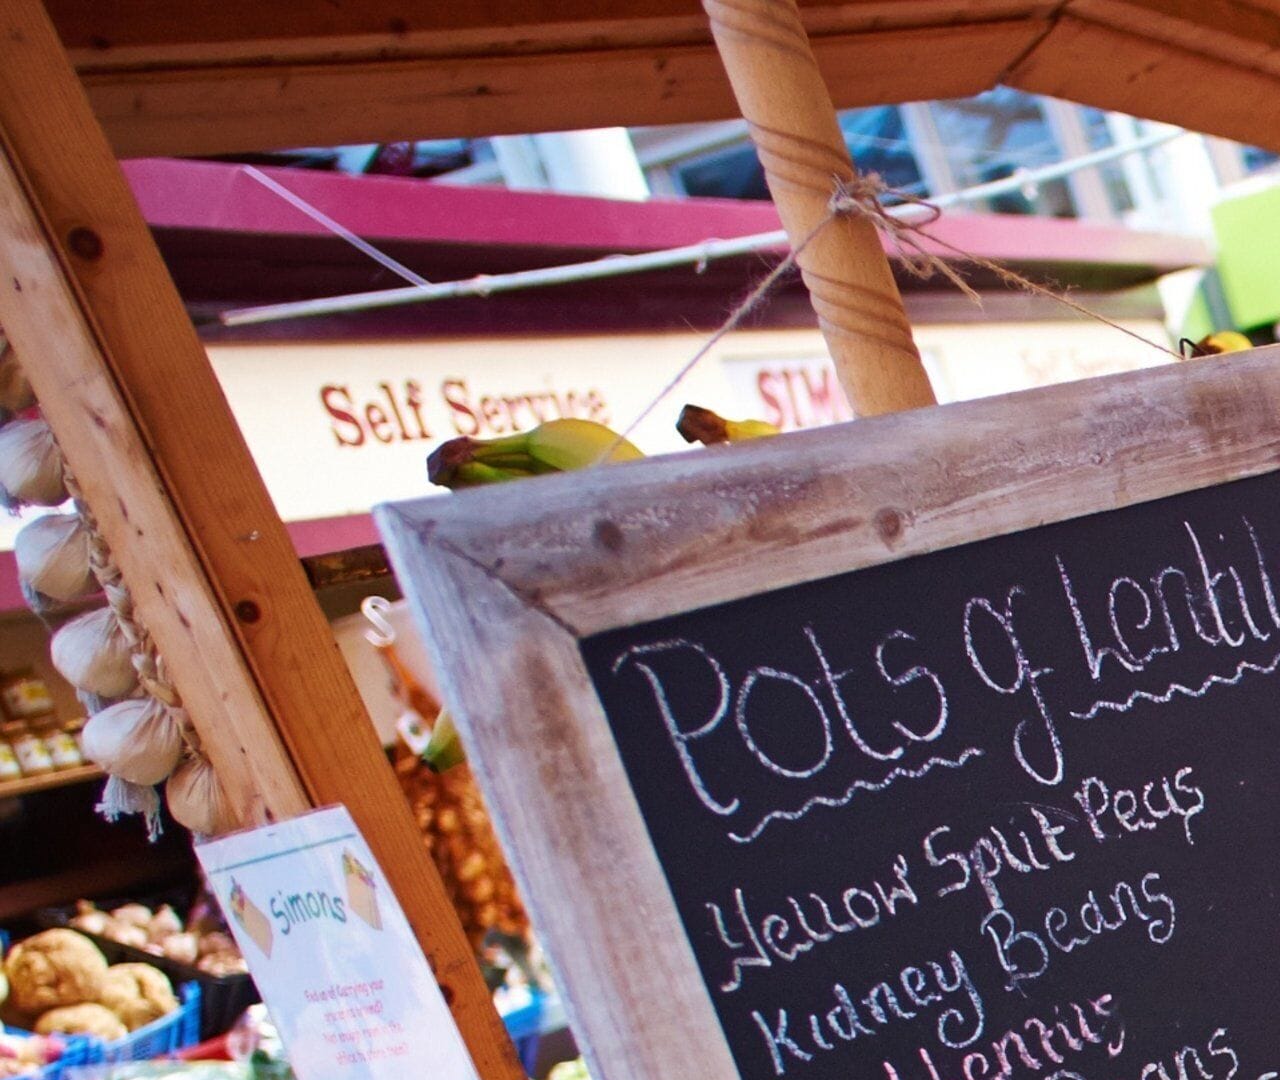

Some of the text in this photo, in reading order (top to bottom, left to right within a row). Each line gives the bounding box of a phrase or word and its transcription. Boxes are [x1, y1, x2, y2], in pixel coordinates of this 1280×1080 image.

[319, 379, 432, 447] Self
[757, 369, 843, 427] SIM
[611, 626, 948, 815] Pots
[270, 889, 347, 935] Simons
[704, 855, 918, 992] Yellow
[1074, 767, 1205, 845] Peas
[751, 872, 1176, 1075] Kidney Beans
